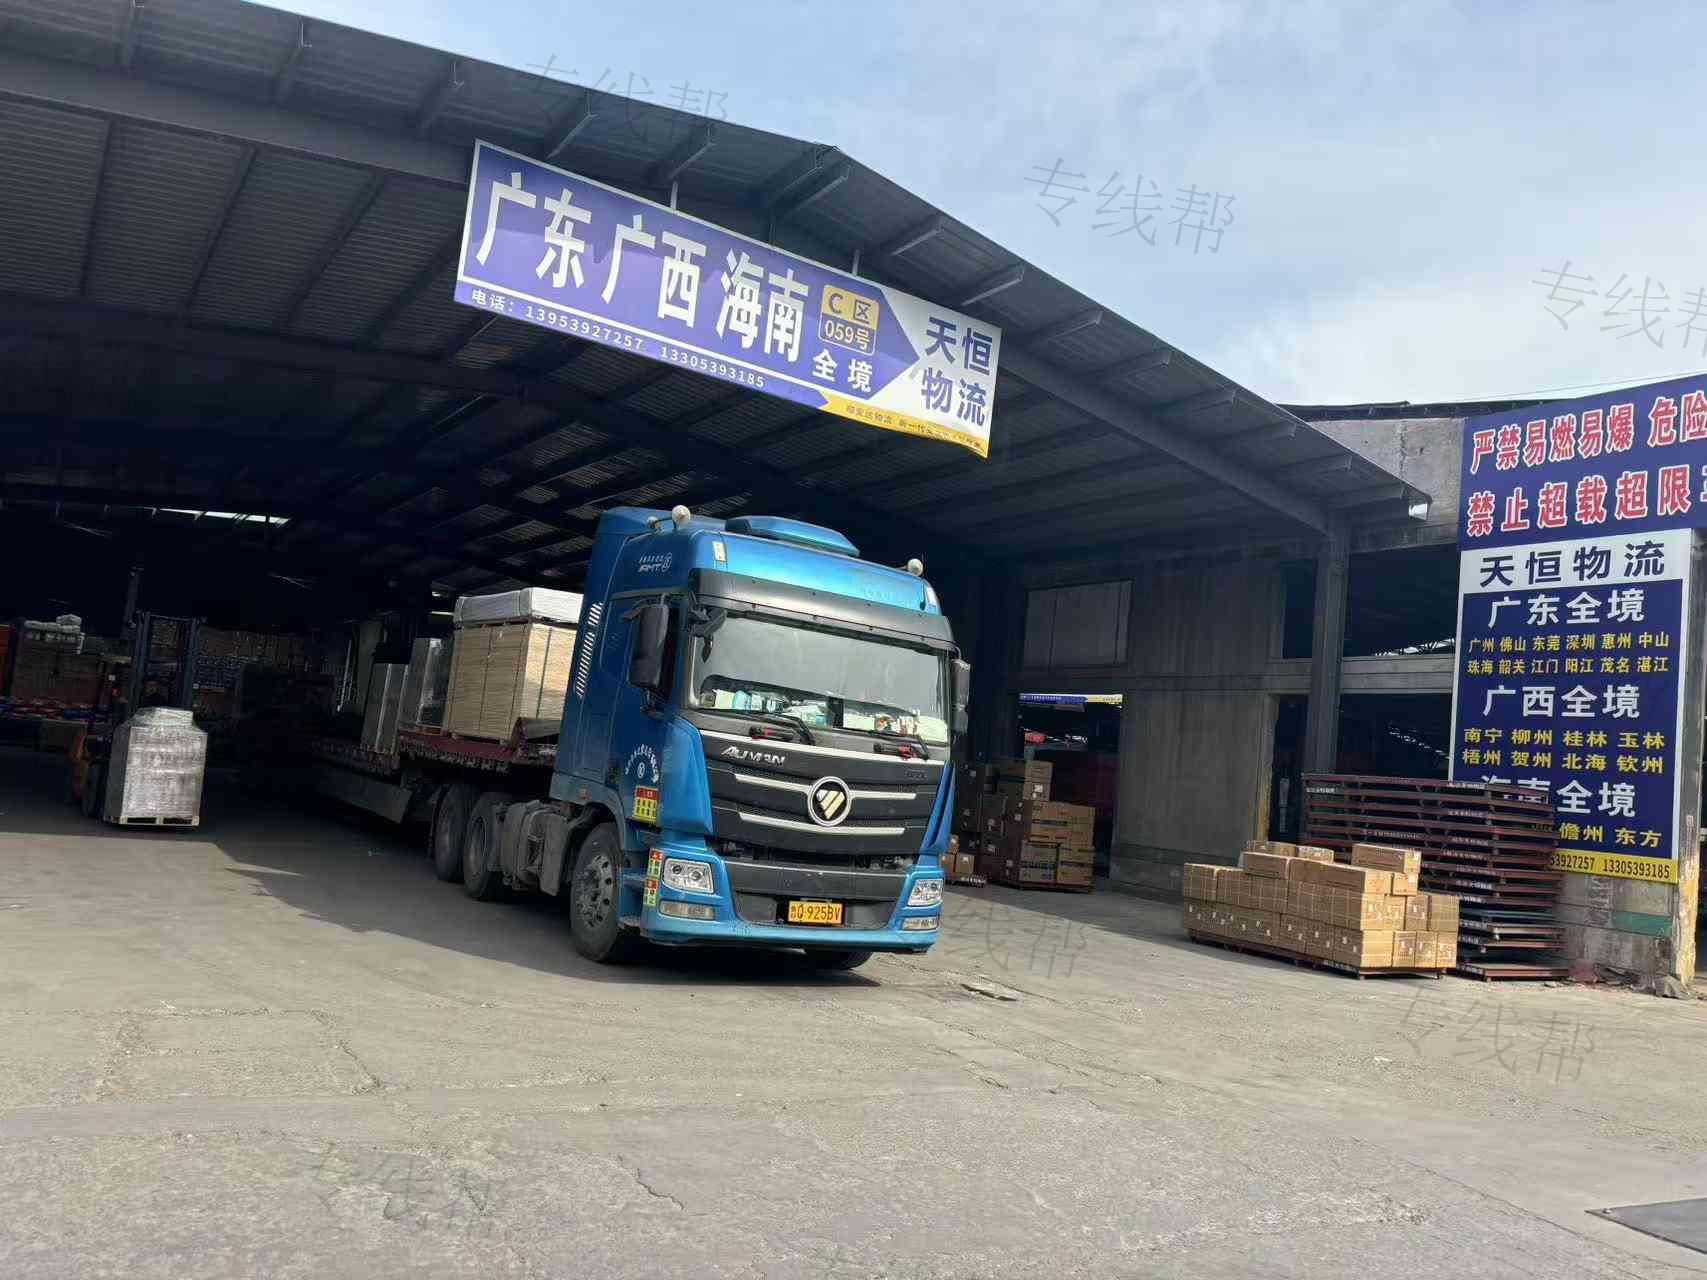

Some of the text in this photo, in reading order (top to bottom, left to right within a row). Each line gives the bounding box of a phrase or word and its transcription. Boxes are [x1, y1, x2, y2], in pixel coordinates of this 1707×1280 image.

[476, 172, 809, 363] 广东 广西 海南
[525, 306, 643, 350] 13953927257
[660, 346, 764, 388] 13305393185
[825, 320, 870, 351] 059号
[925, 316, 993, 376] 天恒
[812, 349, 873, 393] 全境
[921, 367, 987, 427] 物流
[1470, 390, 1707, 474] 严禁易燃易爆 危险
[1467, 464, 1707, 537] 禁止超载超限
[1480, 540, 1664, 588] 天恒物流
[1488, 589, 1644, 628] 广东全境
[1469, 632, 1669, 653] 广州 佛山 东莞 深圳 惠州 中山
[1467, 656, 1669, 675] 珠海 韶关 江门 阳江 茂名 湛江
[1483, 684, 1640, 718] 广西全境
[1464, 728, 1664, 750] 南宁 柳州 桂林 玉林
[1462, 748, 1663, 774] 梧州 贺州 北海 钦州
[1481, 775, 1636, 818] 南全境
[1560, 822, 1603, 842] 儋州
[1615, 827, 1661, 848] 东方
[1603, 859, 1670, 878] 13305393185
